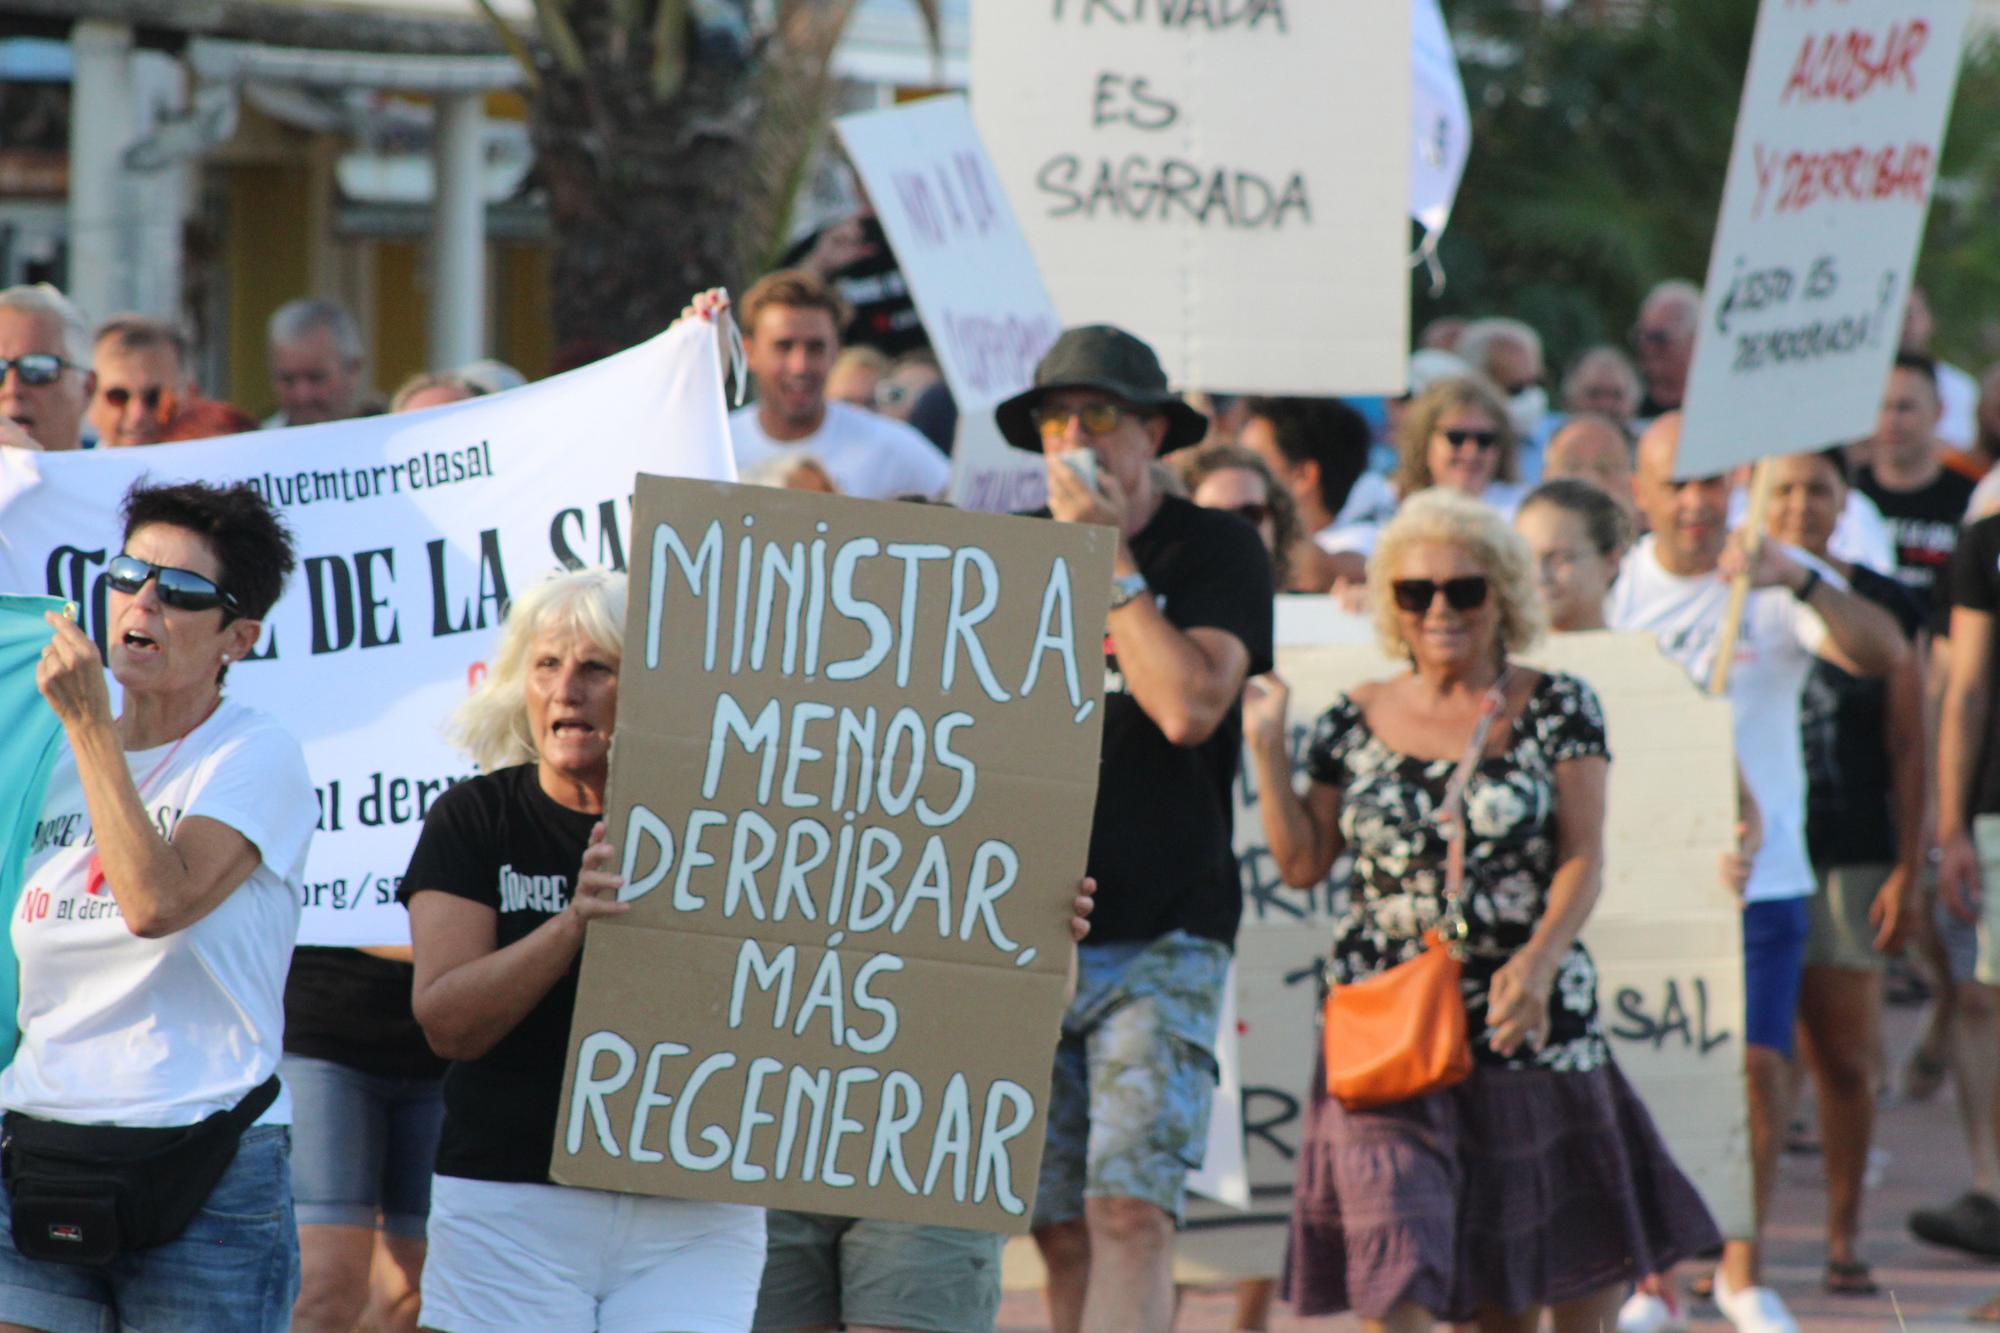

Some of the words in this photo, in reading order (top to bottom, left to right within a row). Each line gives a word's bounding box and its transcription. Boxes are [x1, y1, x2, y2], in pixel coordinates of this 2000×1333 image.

[1093, 71, 1178, 130] ES
[1037, 154, 1311, 228] SAGRADA
[304, 547, 401, 656] DE
[426, 527, 511, 638] LA
[550, 498, 637, 576] SA
[702, 693, 976, 827] MENOS
[57, 897, 74, 920] al
[498, 863, 568, 913] TORRE
[618, 805, 1037, 967] DERRIBAR,
[729, 931, 905, 1055] MÁS
[1610, 976, 1730, 1054] SAL
[567, 1031, 1034, 1215] REGENERAR
